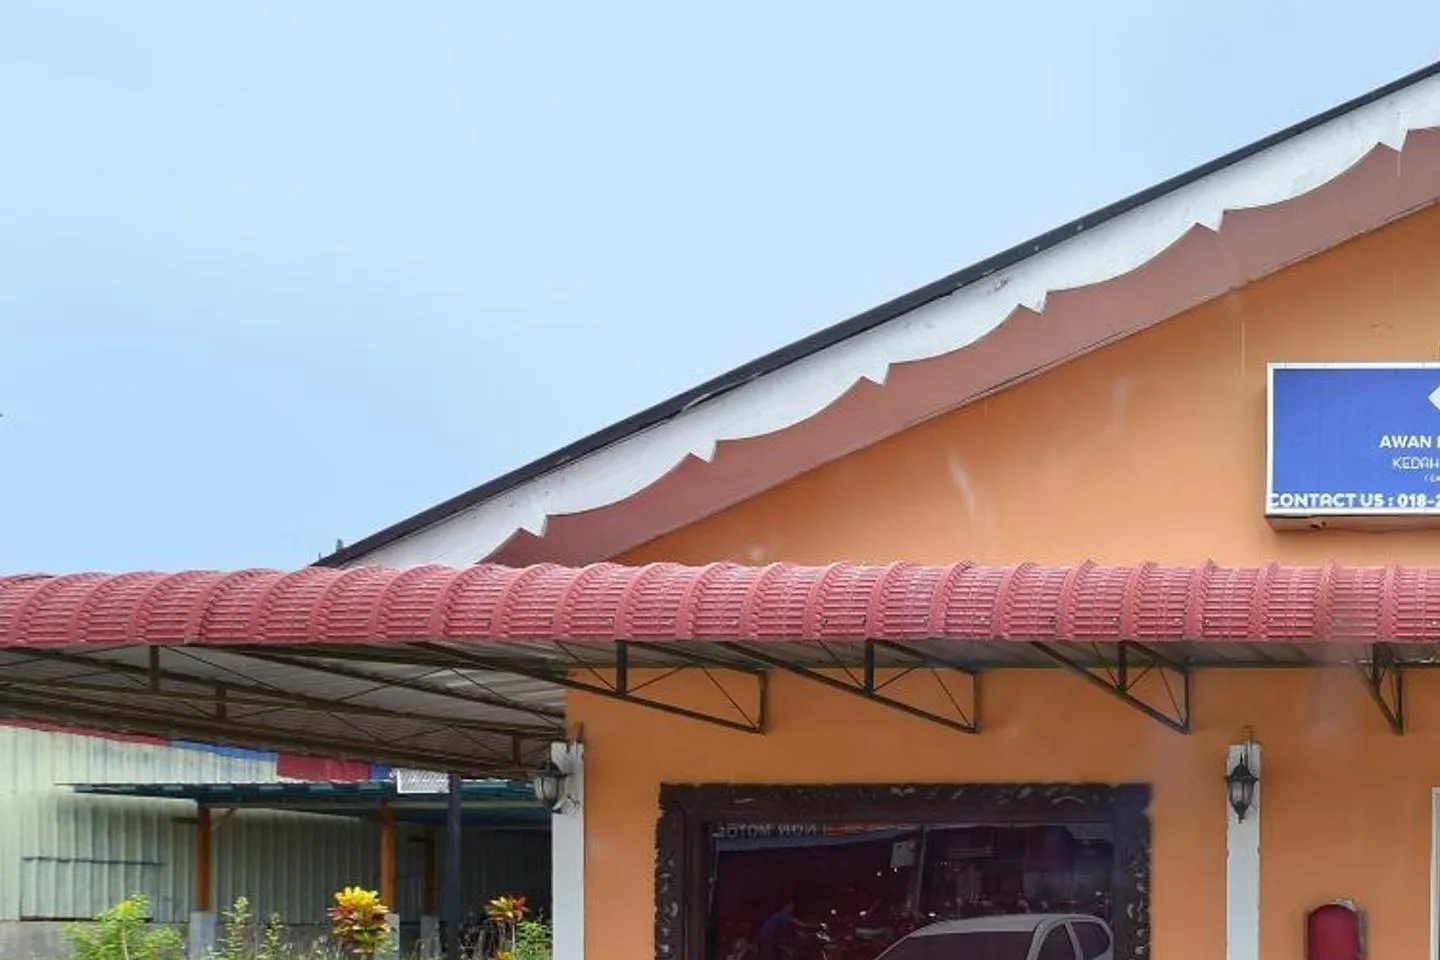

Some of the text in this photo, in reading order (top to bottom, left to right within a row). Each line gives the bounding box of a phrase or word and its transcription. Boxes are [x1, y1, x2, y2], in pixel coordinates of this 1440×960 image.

[1379, 435, 1432, 449] AWAN
[1392, 457, 1439, 470] KEDAH
[1269, 493, 1356, 508] CONTACT
